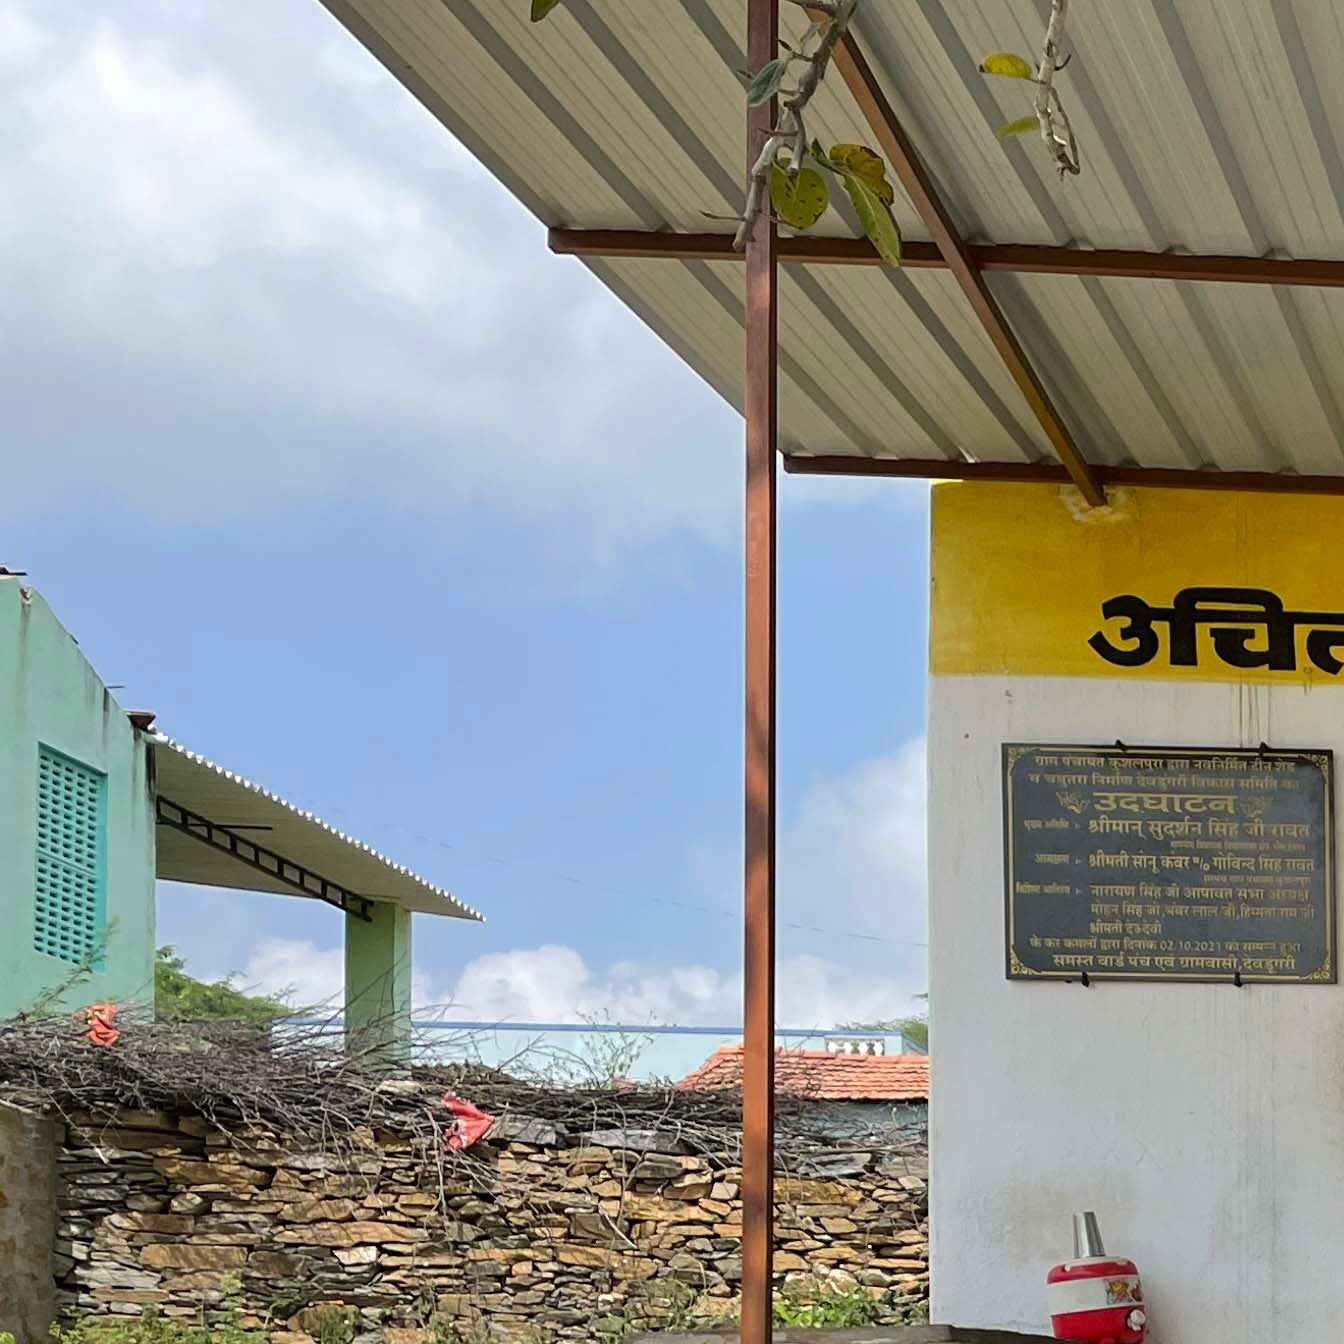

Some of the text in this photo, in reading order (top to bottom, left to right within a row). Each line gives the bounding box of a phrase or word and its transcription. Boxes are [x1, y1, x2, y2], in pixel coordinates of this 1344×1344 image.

[1088, 815, 1147, 840] श्रीमान्
[1147, 815, 1203, 840] सुदर्शन
[1208, 817, 1239, 836] सिंह
[1088, 849, 1130, 869] श्रीमती
[1212, 852, 1256, 872] गोविन्द
[1088, 884, 1136, 897] नारायण
[1052, 953, 1094, 967] समस्त
